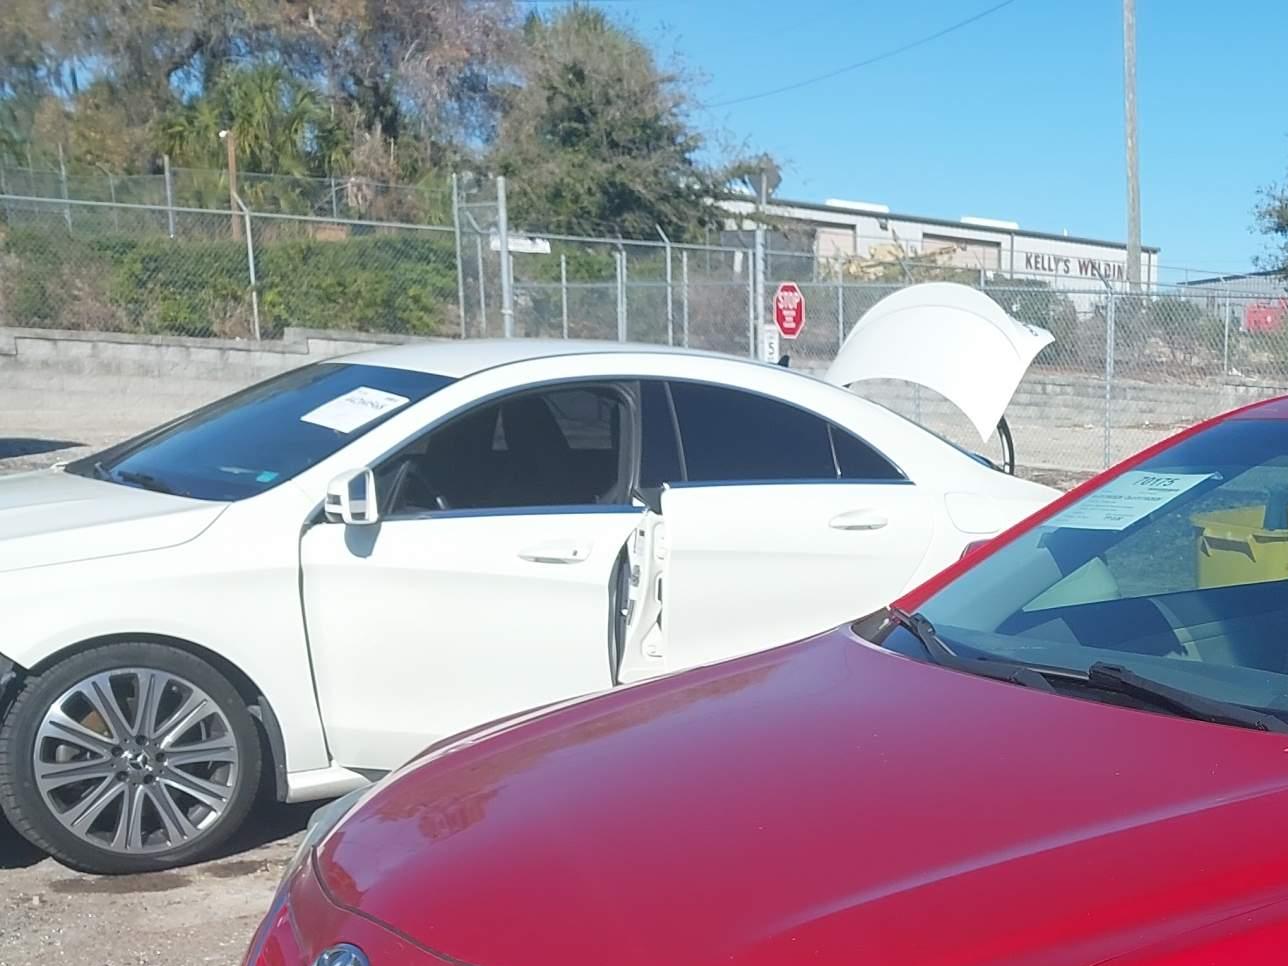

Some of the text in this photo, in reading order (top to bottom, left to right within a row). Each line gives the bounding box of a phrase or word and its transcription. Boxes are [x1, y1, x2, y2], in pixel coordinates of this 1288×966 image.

[1025, 252, 1125, 280] KELLY'S WELDIN
[778, 291, 800, 310] STOP
